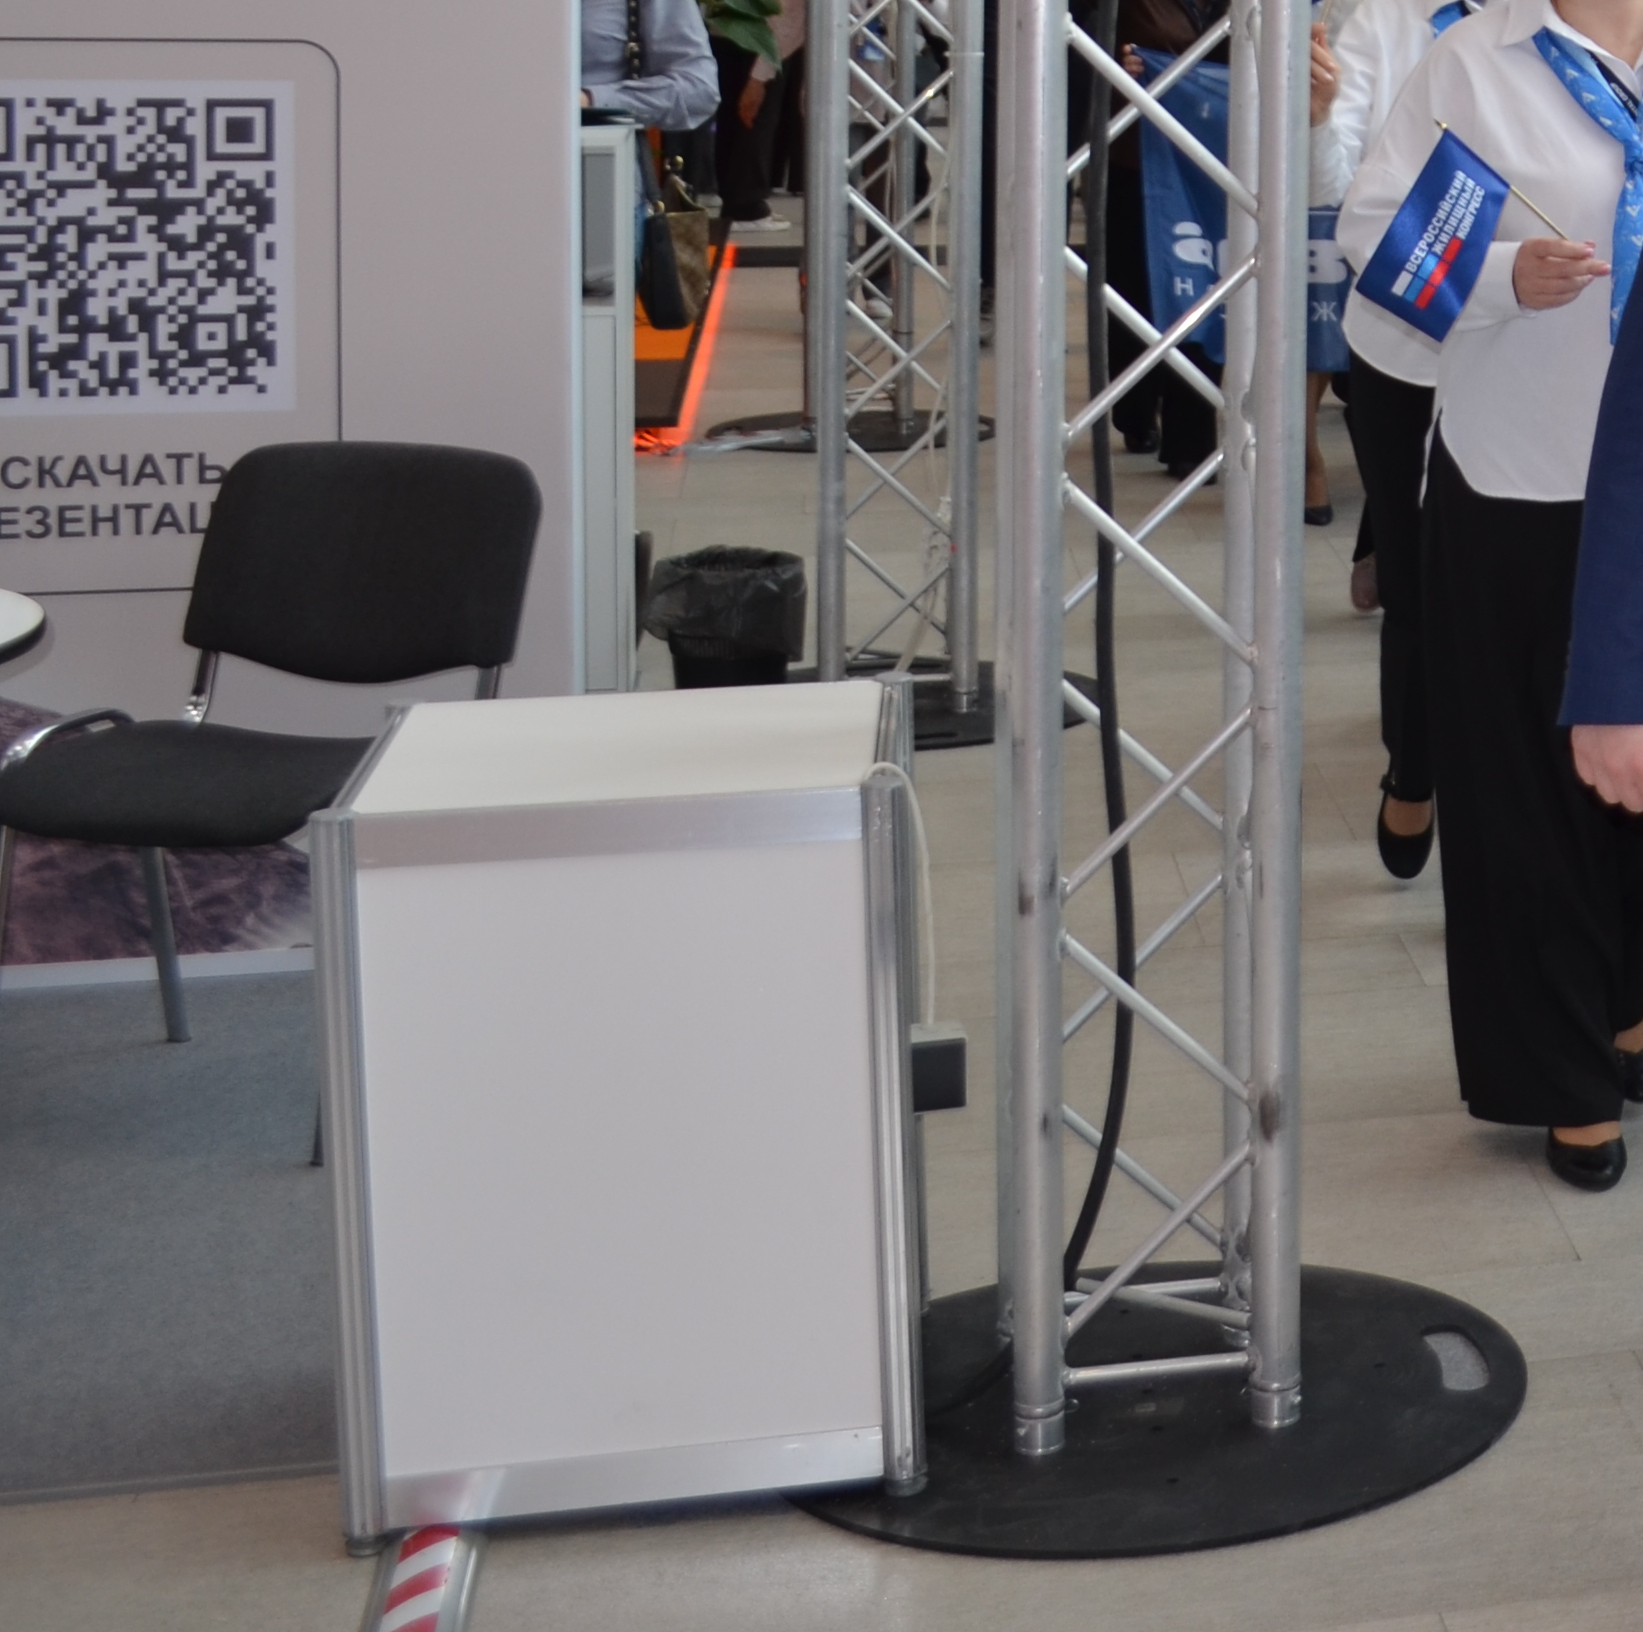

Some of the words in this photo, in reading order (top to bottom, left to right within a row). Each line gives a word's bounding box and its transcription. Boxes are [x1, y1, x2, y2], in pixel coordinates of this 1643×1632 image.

[1405, 169, 1467, 273] ВСЕРОССИЙСКИЙ
[1431, 177, 1476, 256] ЖИЛИЩНЫЙ
[1456, 185, 1485, 240] КОНГРЕСС
[0, 452, 229, 490] СКАЧАТЬ
